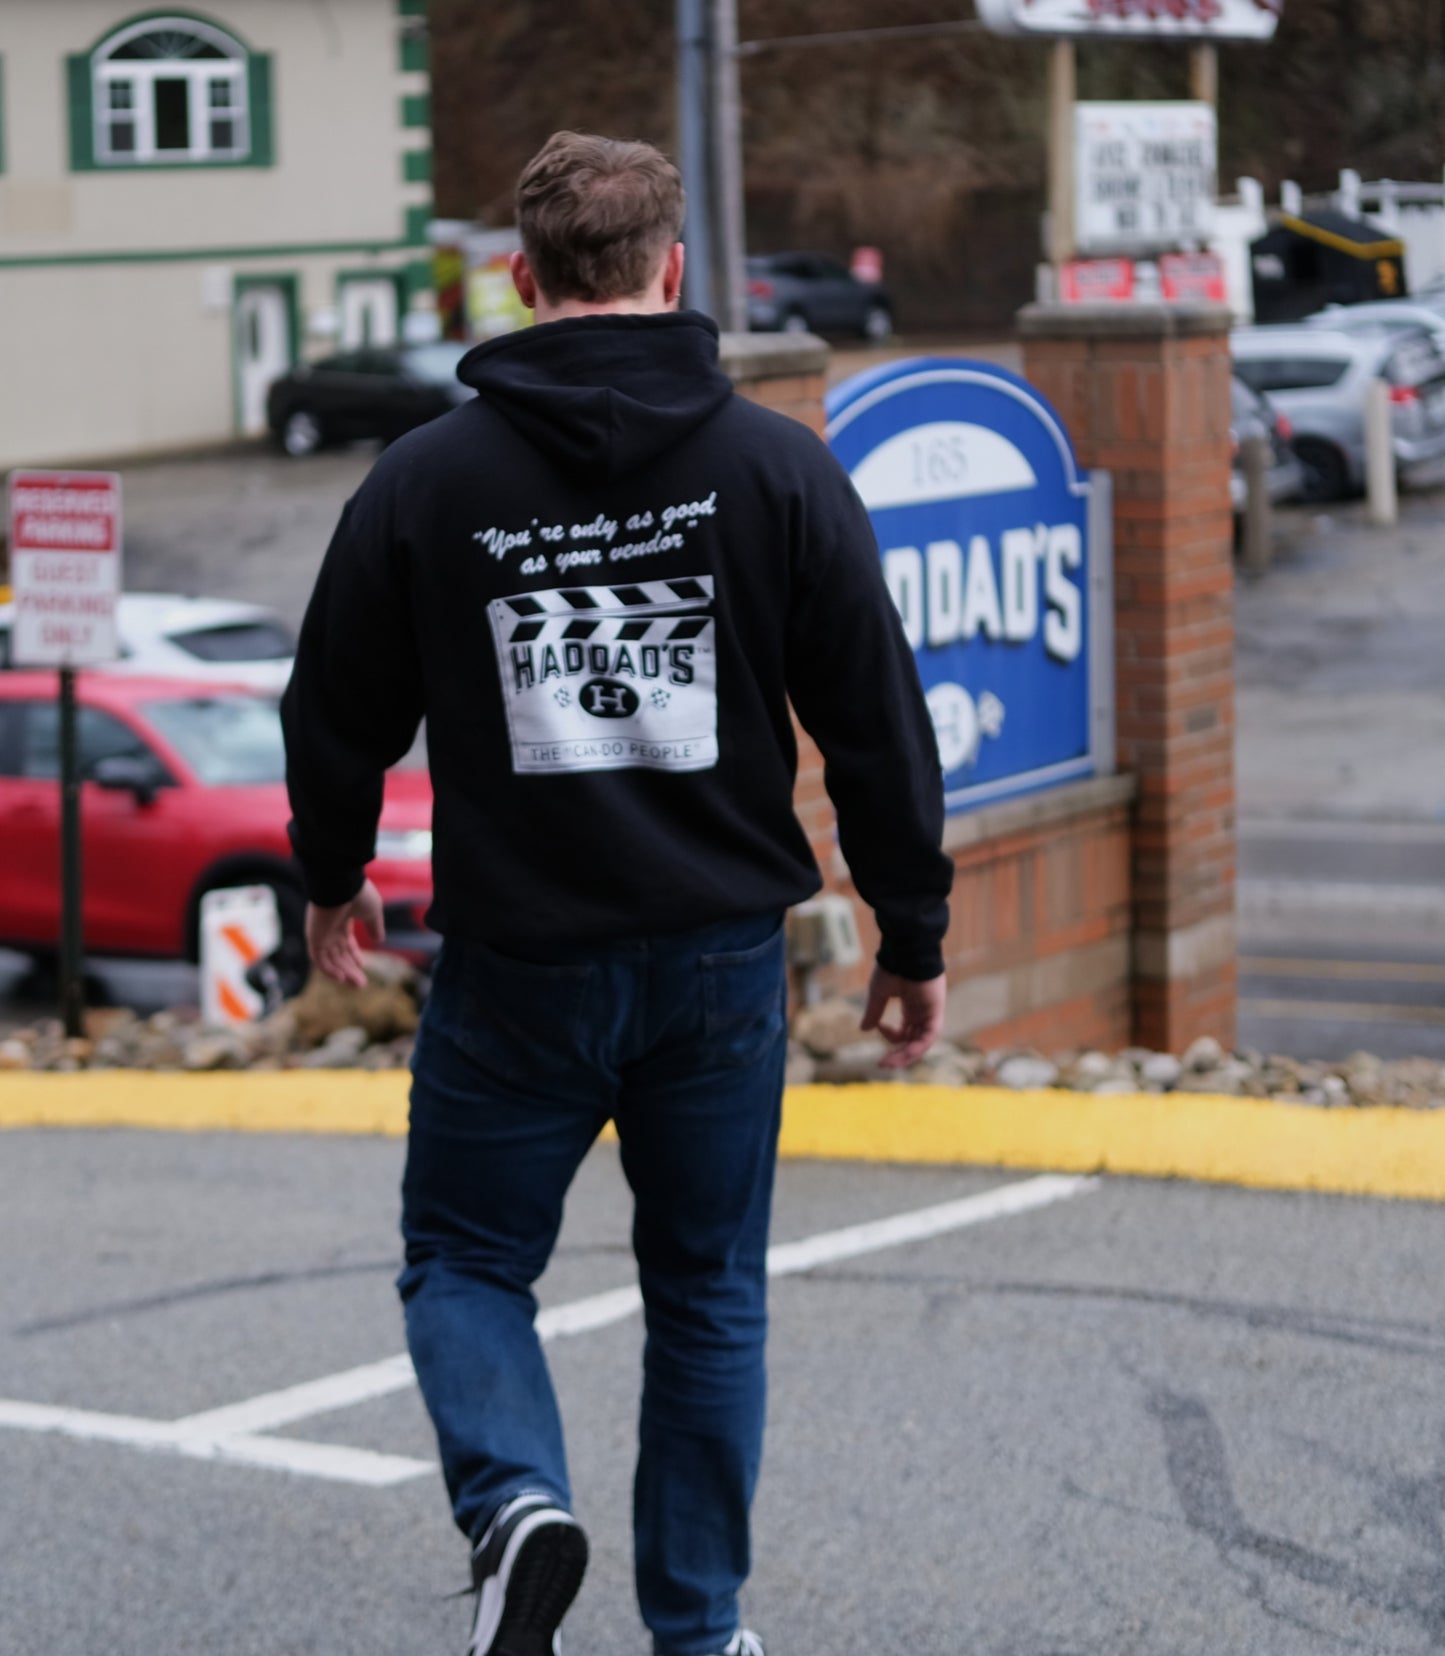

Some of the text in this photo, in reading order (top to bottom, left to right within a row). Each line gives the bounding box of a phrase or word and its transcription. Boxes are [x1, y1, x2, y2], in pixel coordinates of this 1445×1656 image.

[569, 513, 618, 542] only
[625, 510, 654, 530] as
[661, 491, 717, 530] good
[520, 554, 548, 575] as
[554, 549, 602, 574] your
[884, 523, 1082, 663] DDAD'S
[509, 641, 695, 694] HADDAD'S
[589, 684, 627, 713] H
[531, 746, 562, 762] THE
